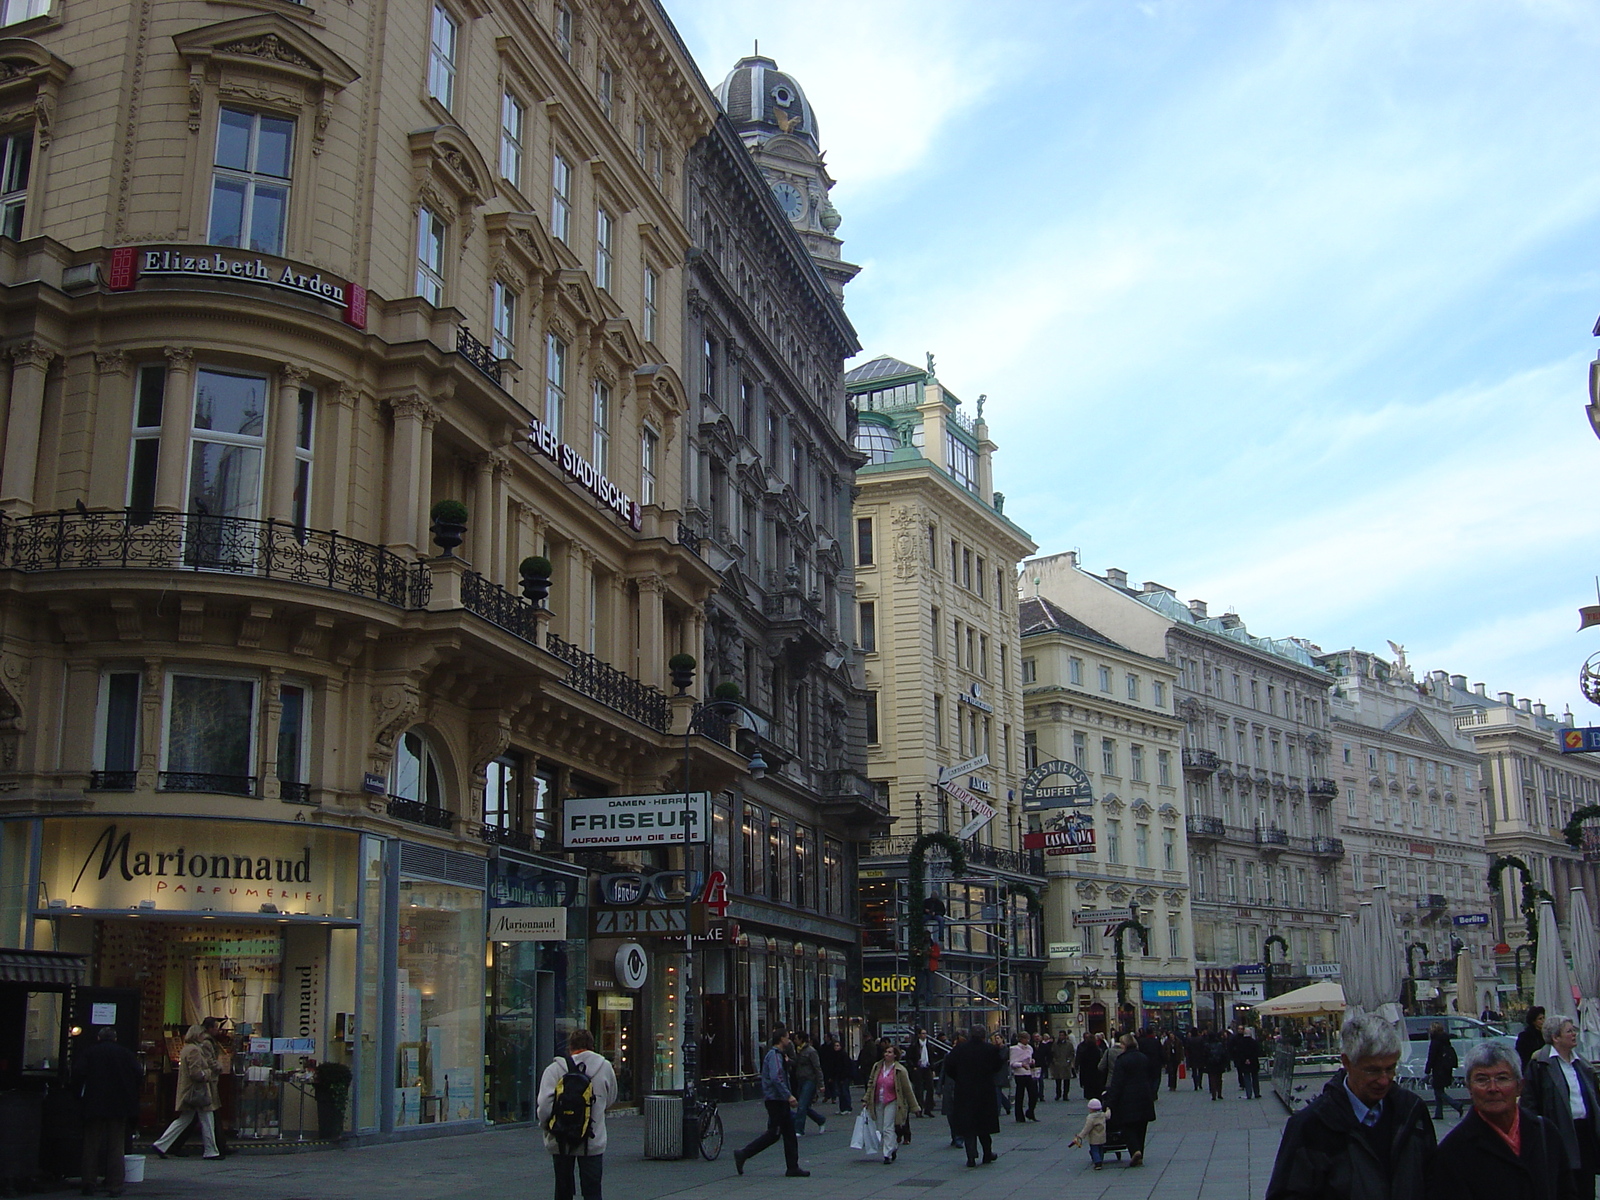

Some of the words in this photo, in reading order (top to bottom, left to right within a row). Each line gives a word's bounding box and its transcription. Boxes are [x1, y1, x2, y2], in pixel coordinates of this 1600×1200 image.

[144, 251, 269, 280] Elizabeth
[281, 265, 344, 301] Arden
[528, 419, 558, 461] NER
[563, 443, 631, 521] STÄDTISCHE
[945, 782, 993, 819] FLEDERMAUS
[1035, 786, 1078, 798] BUFFET
[608, 800, 646, 808] DAMEN
[571, 810, 698, 831] FRISEUR
[571, 836, 620, 845] AUFGANG
[670, 832, 698, 840] ECE
[72, 824, 312, 893] Marionnaud
[156, 880, 323, 903] PARFUMERIES
[494, 915, 556, 935] Marionnaud
[596, 909, 687, 933] ZEISS
[1459, 915, 1485, 924] Berlitz
[1311, 963, 1339, 975] HABAN
[862, 974, 917, 993] SCHÖPS
[1195, 968, 1240, 992] LISKA
